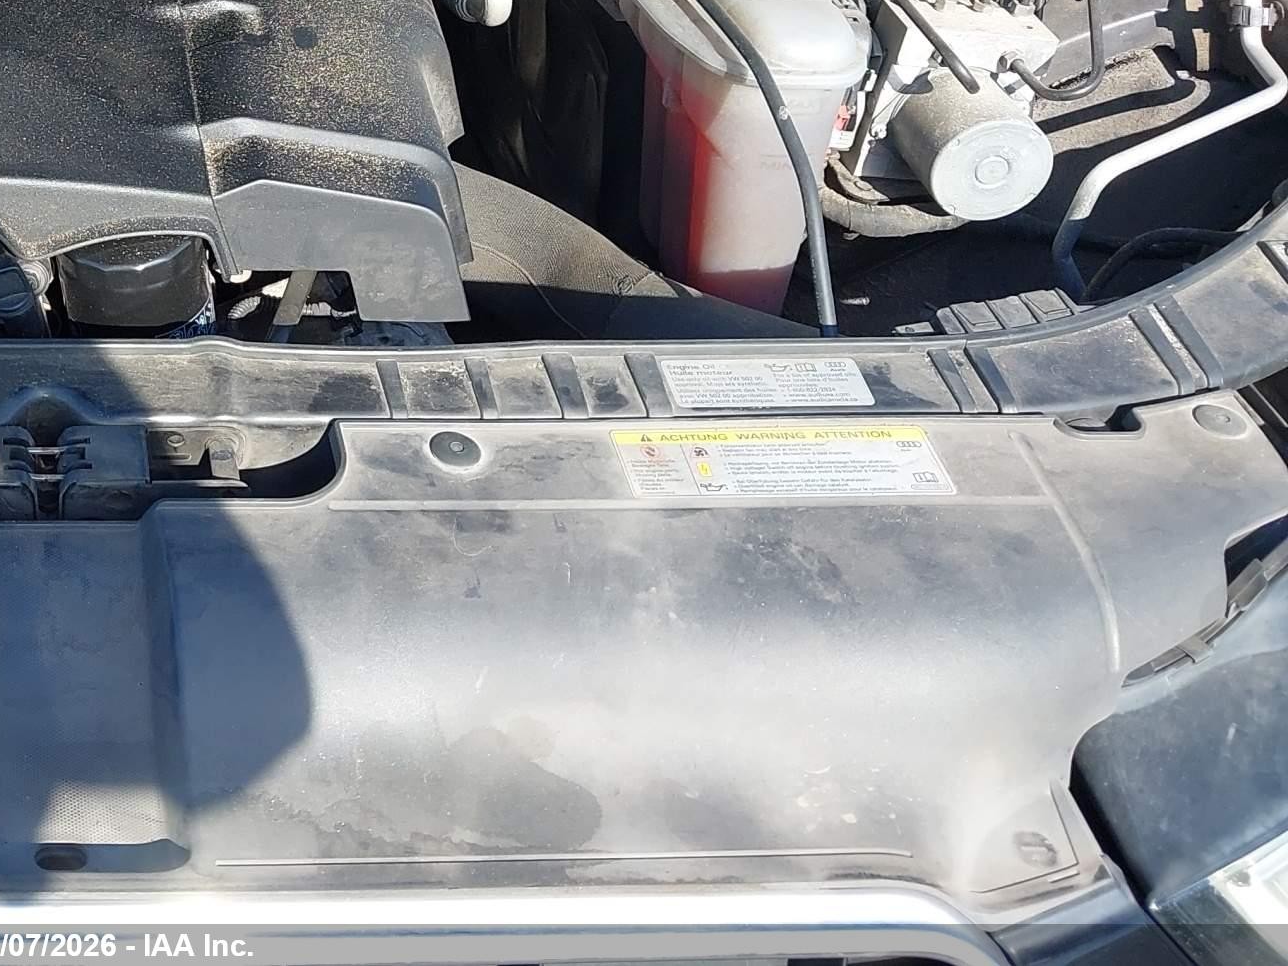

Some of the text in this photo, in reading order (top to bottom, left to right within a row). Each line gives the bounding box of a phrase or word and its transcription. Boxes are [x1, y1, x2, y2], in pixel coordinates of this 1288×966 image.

[660, 430, 892, 442] ACHTUNG WARNING ATTENTION
